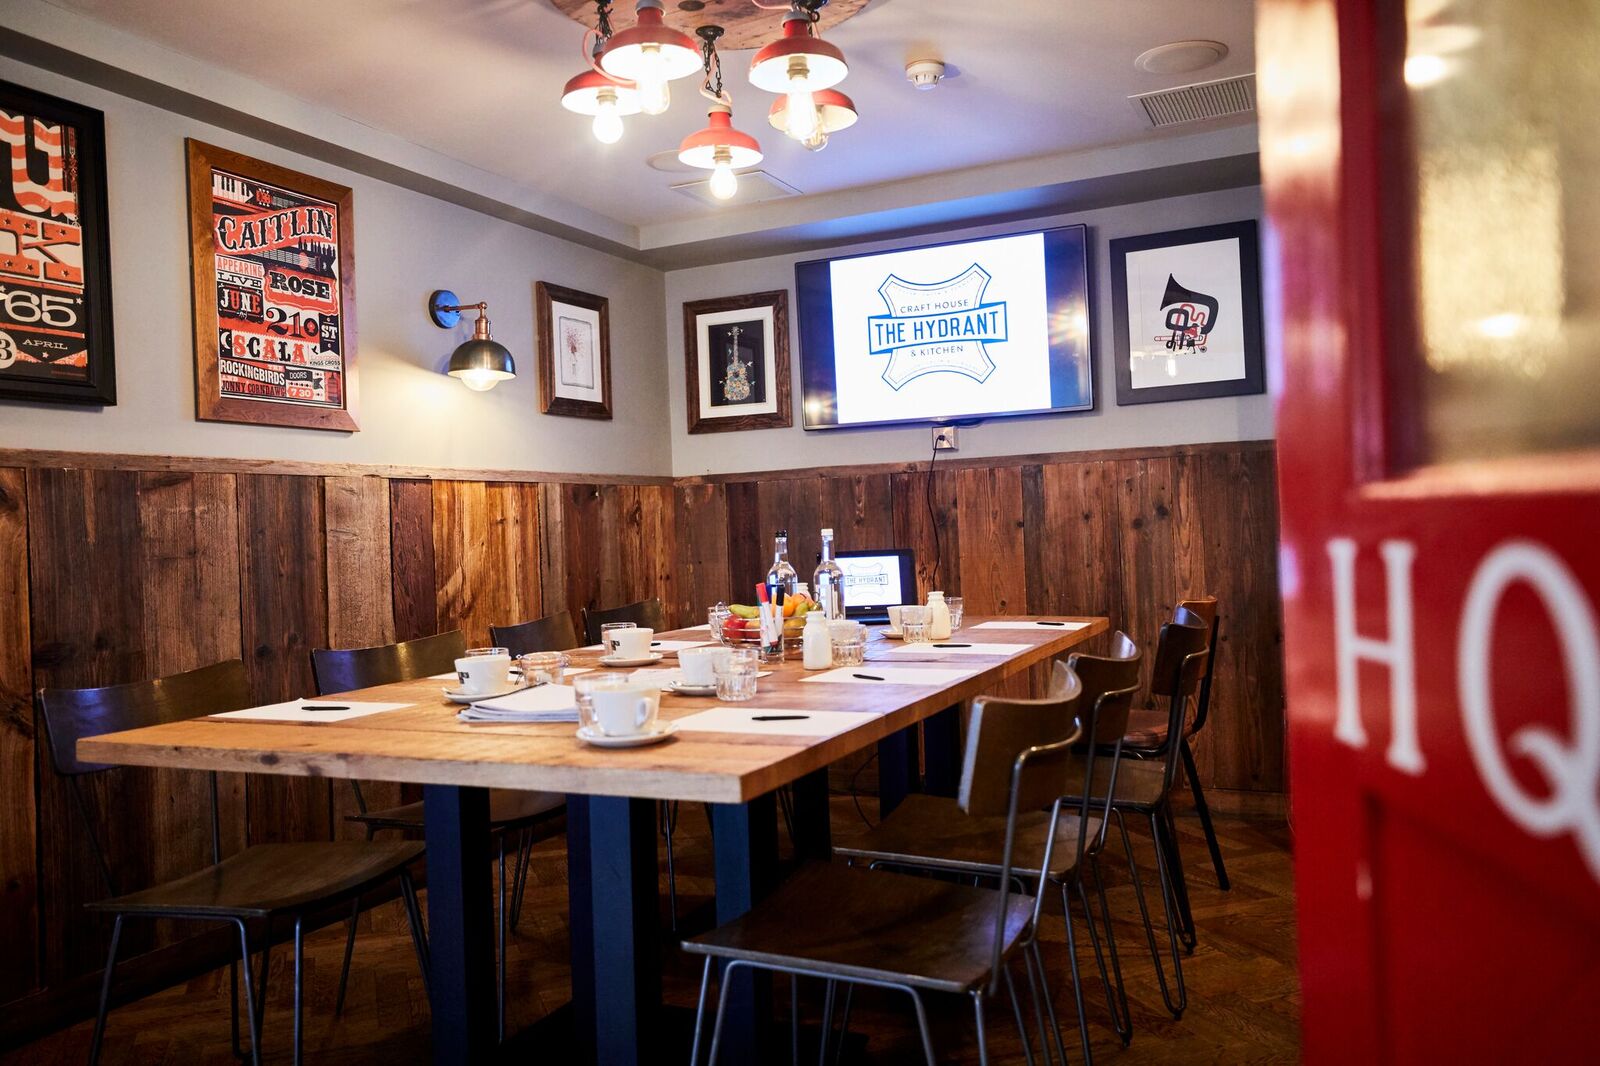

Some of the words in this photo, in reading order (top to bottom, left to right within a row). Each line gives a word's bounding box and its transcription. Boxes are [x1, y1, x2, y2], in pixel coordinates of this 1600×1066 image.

[217, 208, 334, 251] CAITLIN
[217, 257, 263, 278] APPEARING
[217, 272, 262, 289] LIVE
[269, 271, 330, 299] ROSE
[220, 288, 261, 314] JUNE
[900, 304, 931, 314] CRAFT
[934, 299, 969, 310] HOUSE
[321, 325, 338, 340] ST
[875, 322, 906, 346] THE
[913, 311, 999, 340] HYDRANT
[22, 338, 68, 350] APRIL
[233, 334, 307, 366] SCALA
[910, 349, 917, 357] &
[920, 345, 964, 356] KITCHEN
[220, 359, 285, 386] ROCKINGBIRDS
[289, 371, 308, 379] DOORS
[221, 380, 246, 393] JONNY
[1326, 536, 1600, 887] HQ
